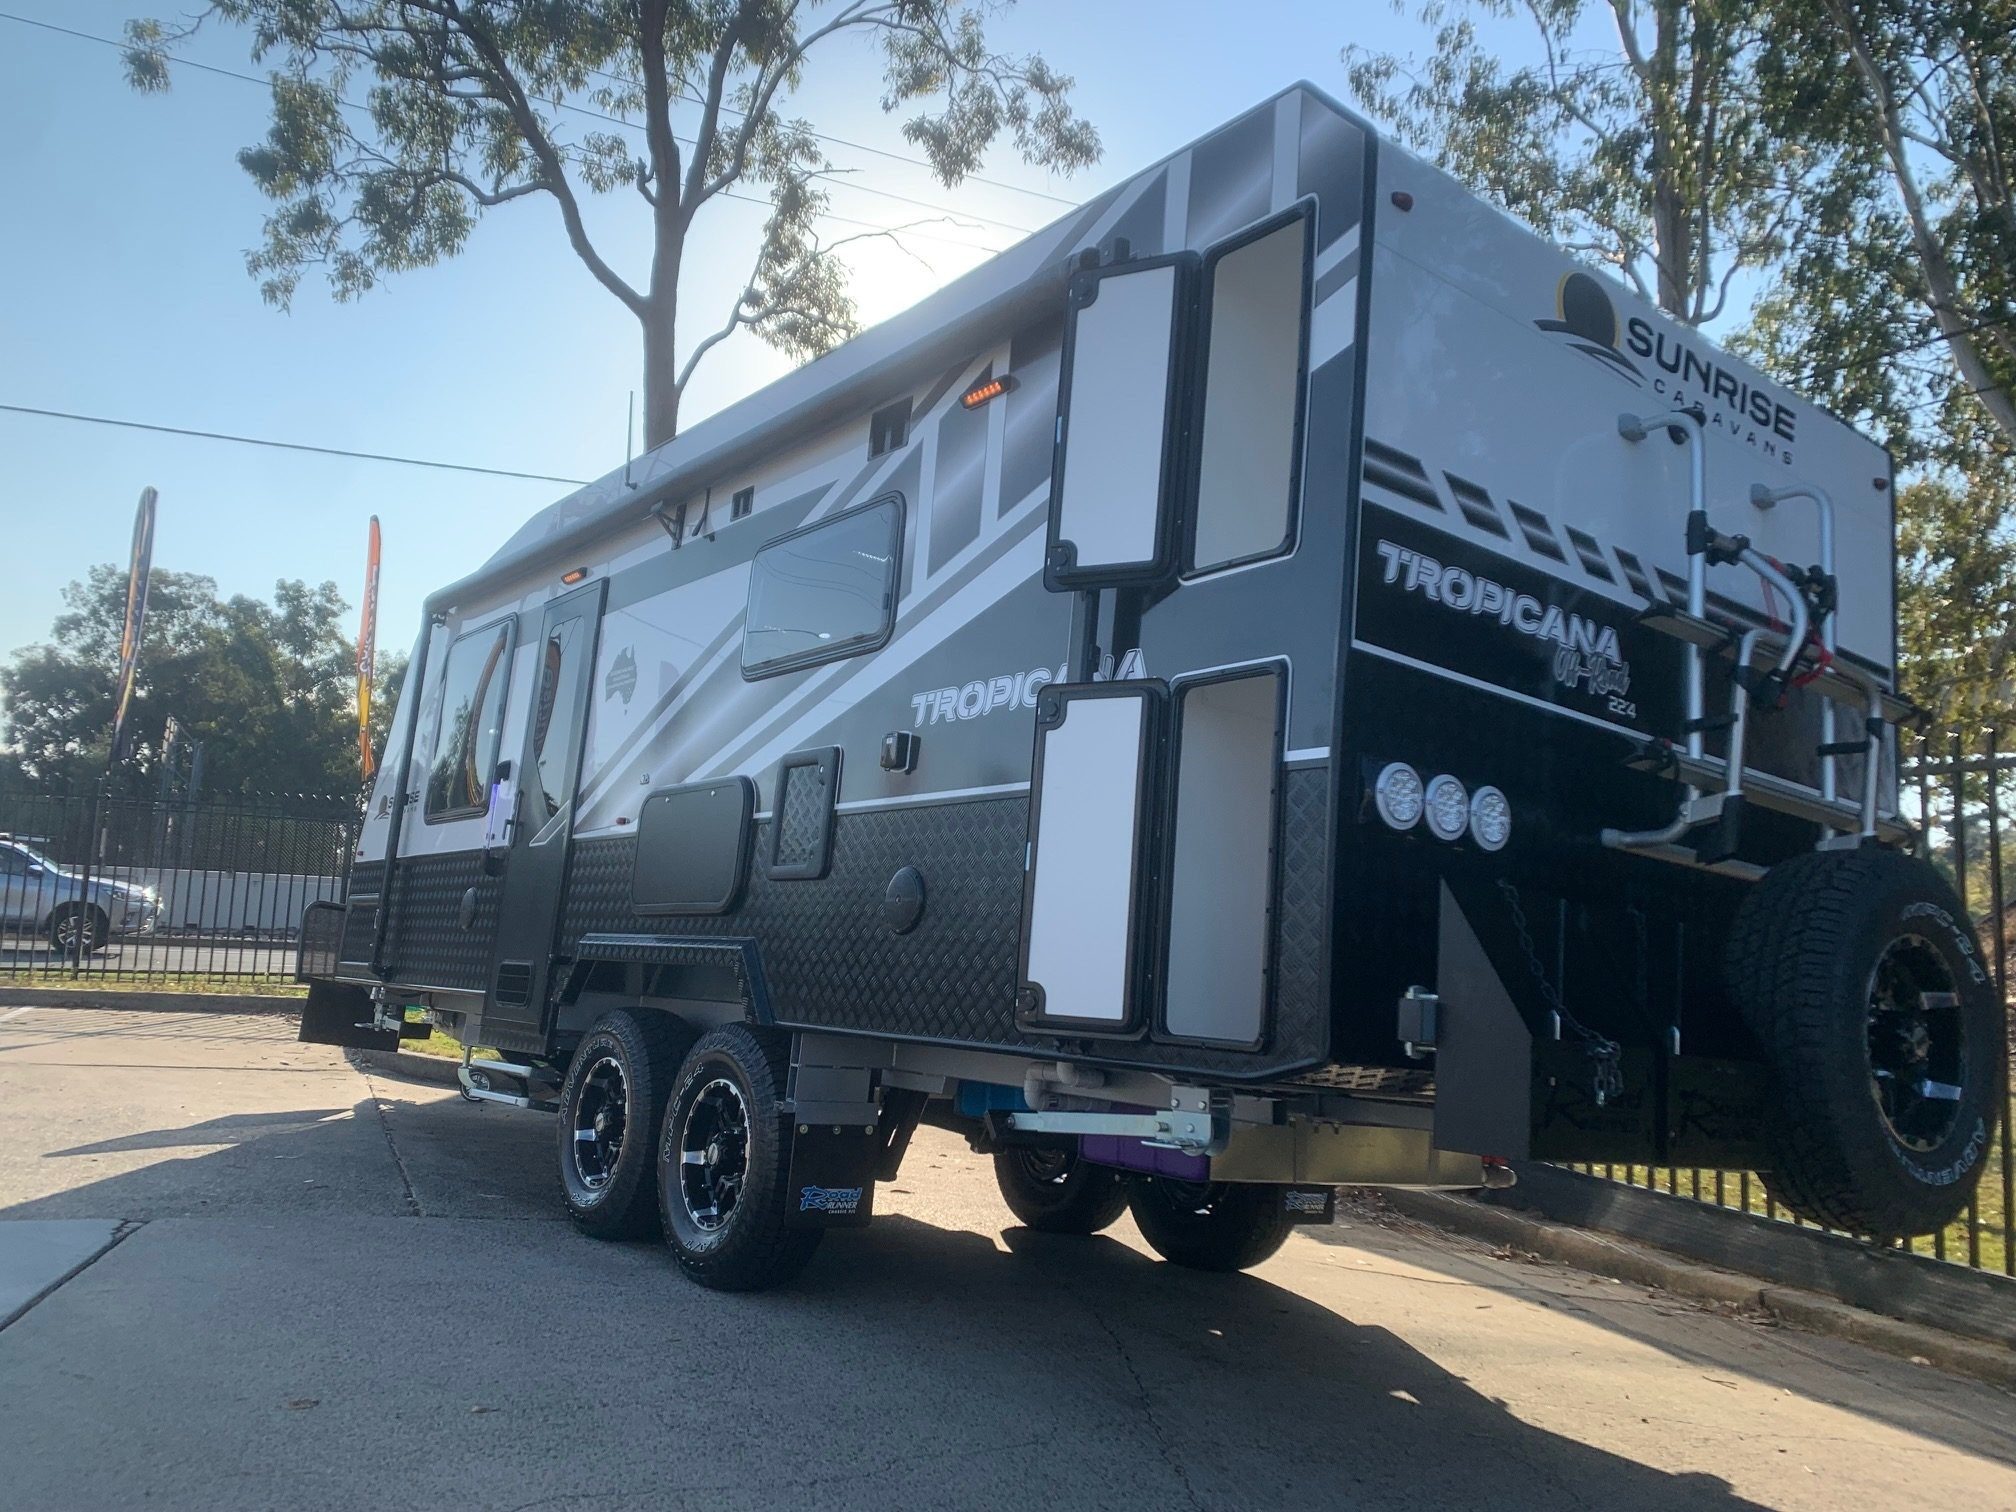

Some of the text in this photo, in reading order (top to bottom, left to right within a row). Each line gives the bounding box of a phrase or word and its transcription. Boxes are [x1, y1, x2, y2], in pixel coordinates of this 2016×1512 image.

[1626, 316, 1797, 443] SUNRISE
[1376, 538, 1622, 667] TROPICANA
[1608, 695, 1637, 719] 224
